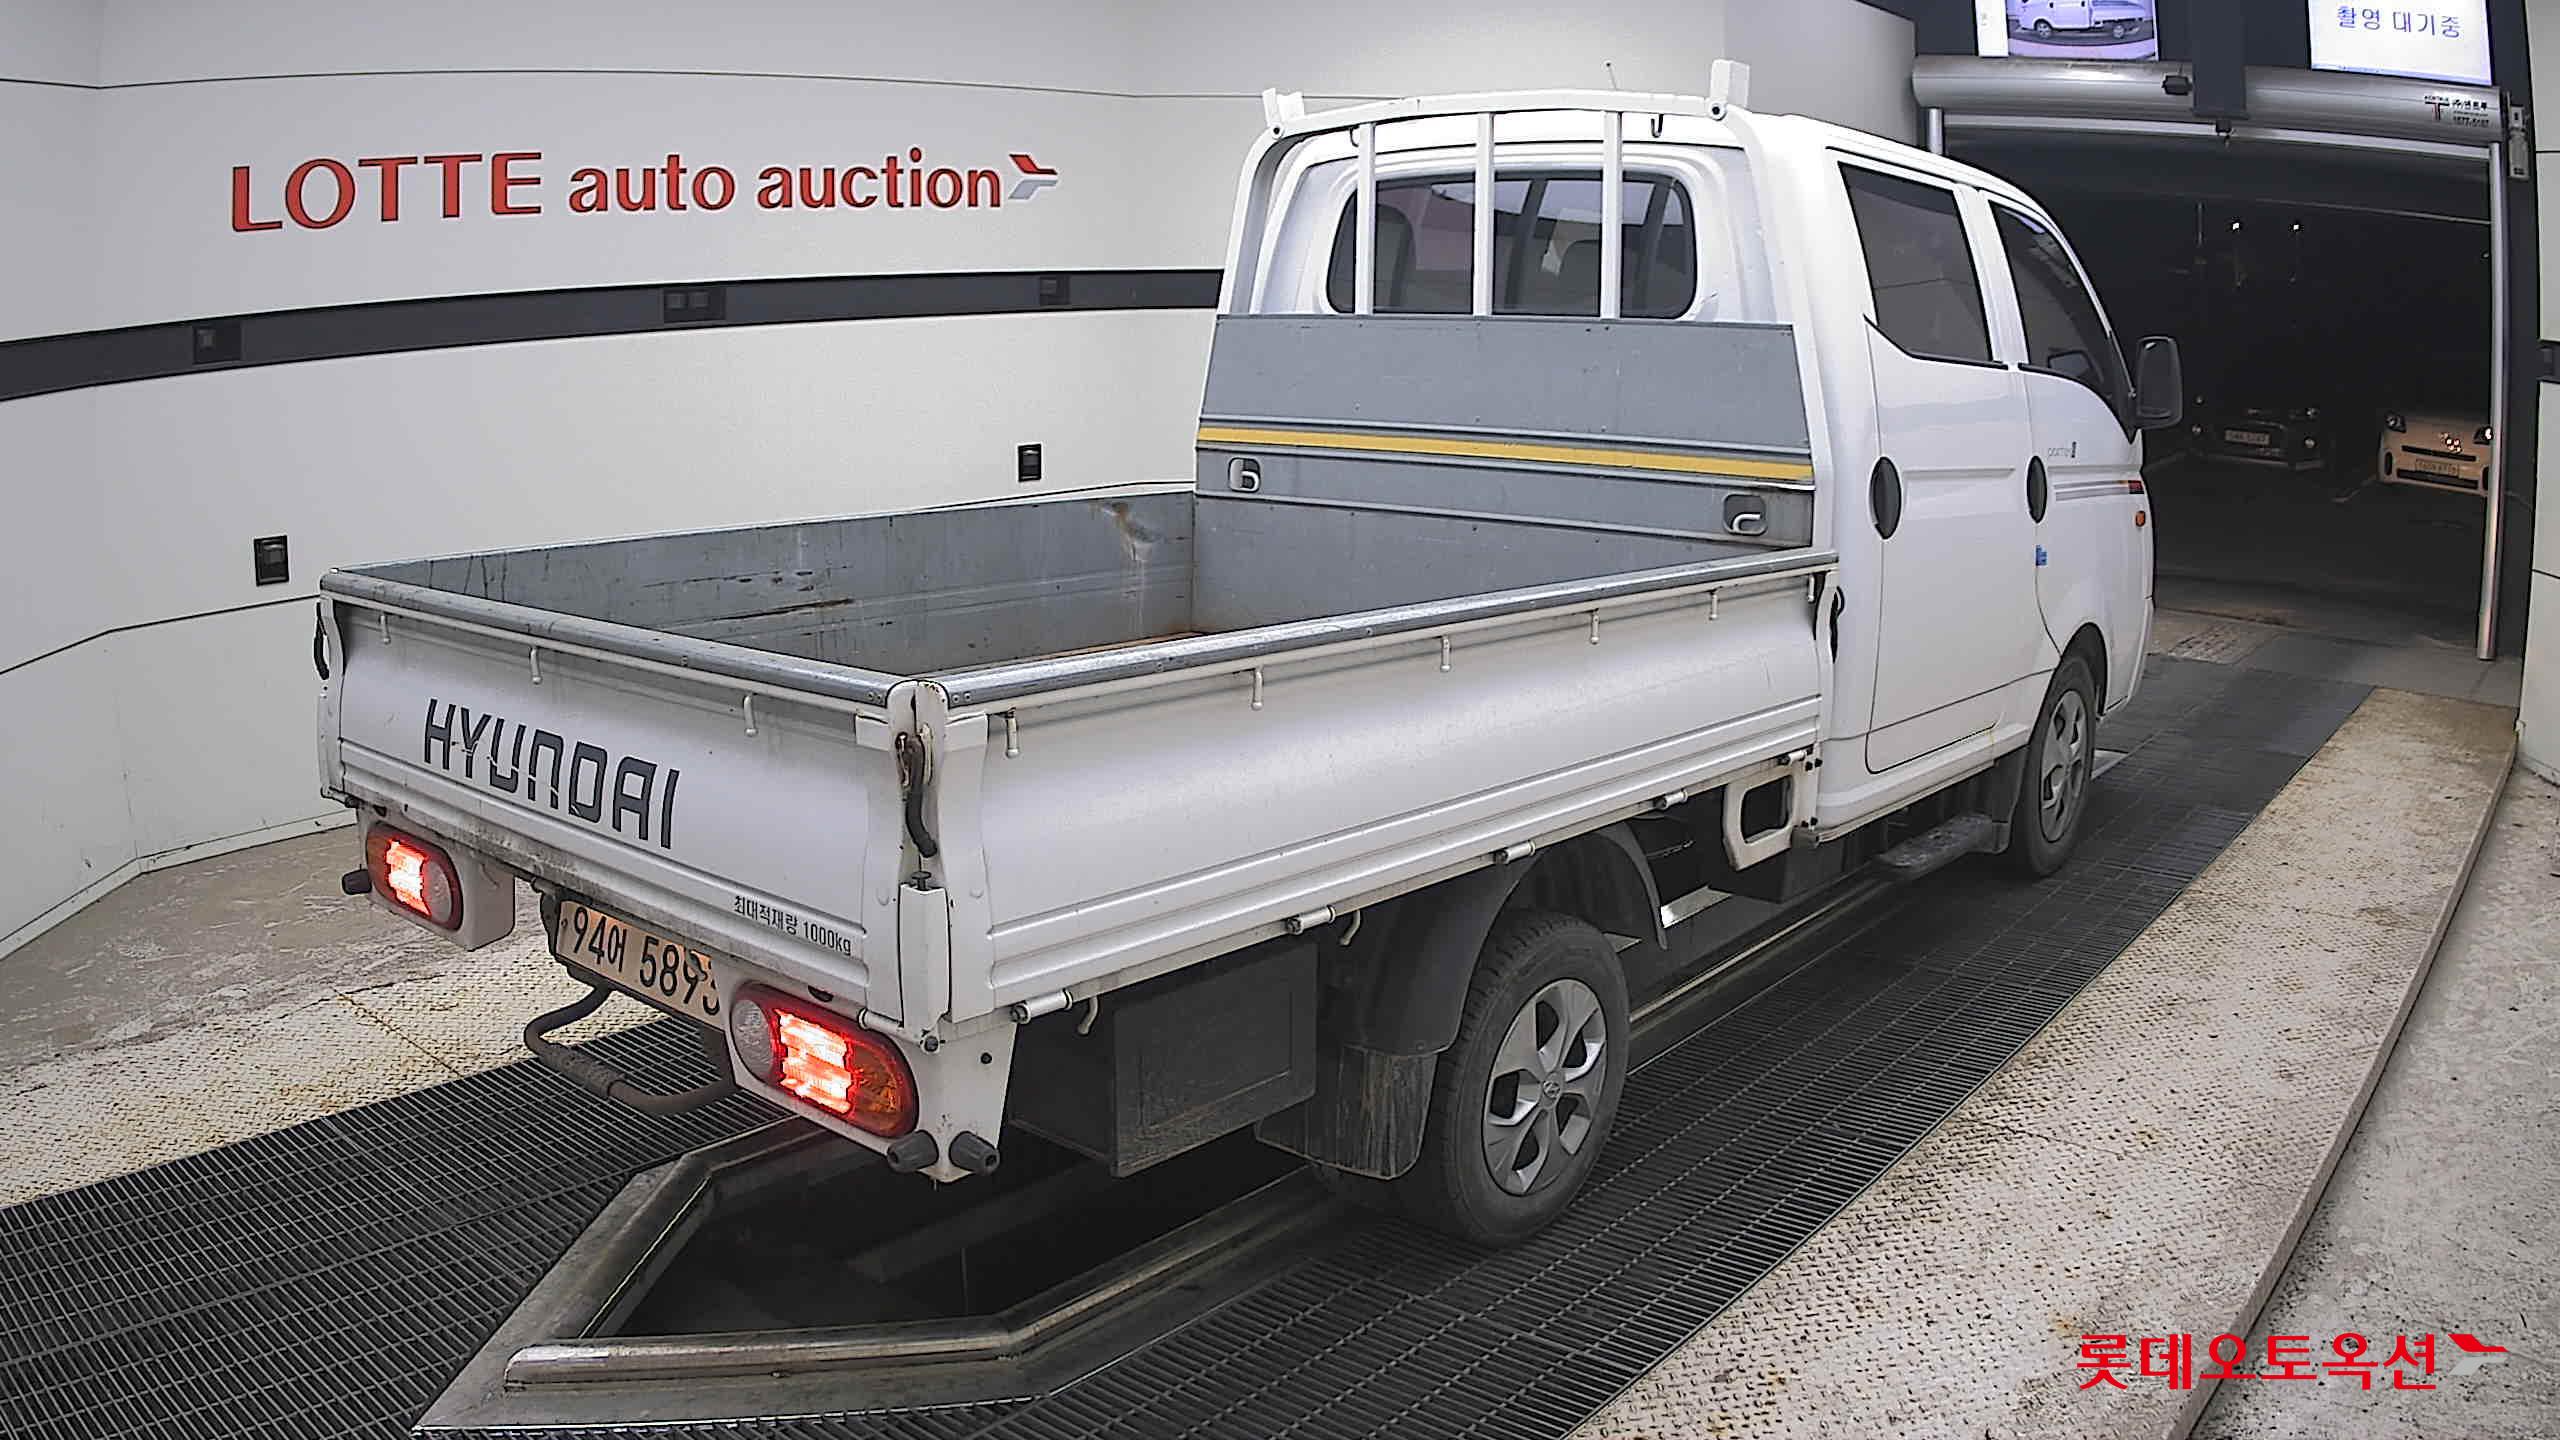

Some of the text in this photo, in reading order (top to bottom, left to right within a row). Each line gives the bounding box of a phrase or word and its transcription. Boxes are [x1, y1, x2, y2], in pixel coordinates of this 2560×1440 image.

[2337, 5, 2461, 39] 촬영 대기중
[231, 146, 1002, 233] LOTTE auto auction
[422, 697, 680, 850] HYUNDAI
[573, 905, 628, 973] 94어
[733, 894, 852, 957] 최대적재량 1000kg
